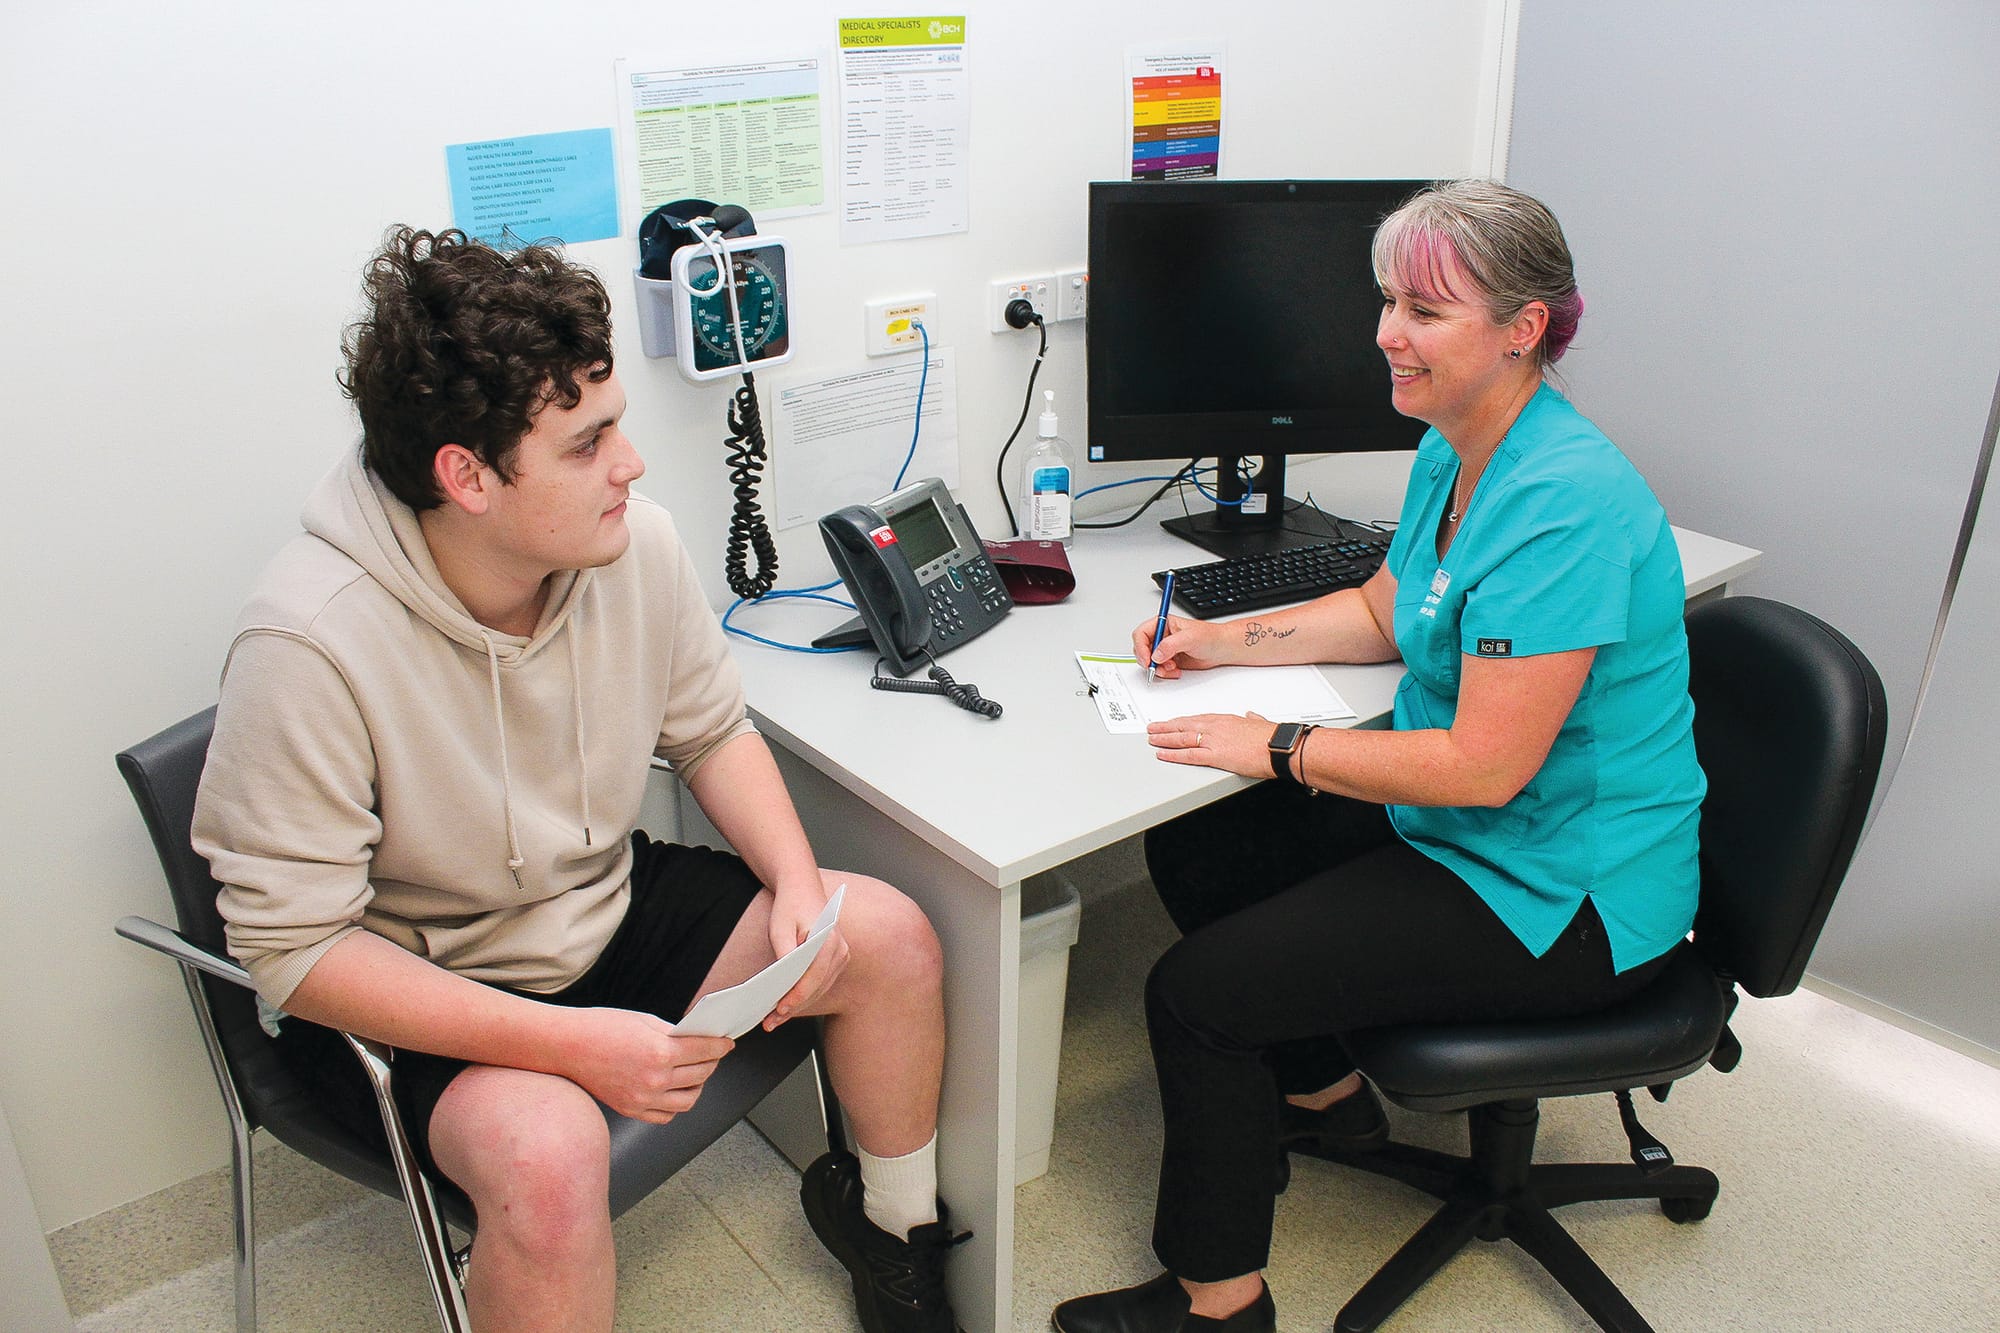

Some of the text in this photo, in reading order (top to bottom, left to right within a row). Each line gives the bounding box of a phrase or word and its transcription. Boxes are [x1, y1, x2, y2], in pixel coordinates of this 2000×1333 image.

[842, 20, 920, 30] MEDICAL SPECIALISTS
[942, 24, 960, 34] BCH
[843, 35, 884, 44] DIRECTORY
[761, 287, 770, 295] 220
[763, 300, 773, 309] 240
[761, 315, 770, 323] 260
[1272, 416, 1293, 424] DELL
[1480, 642, 1495, 652] koi
